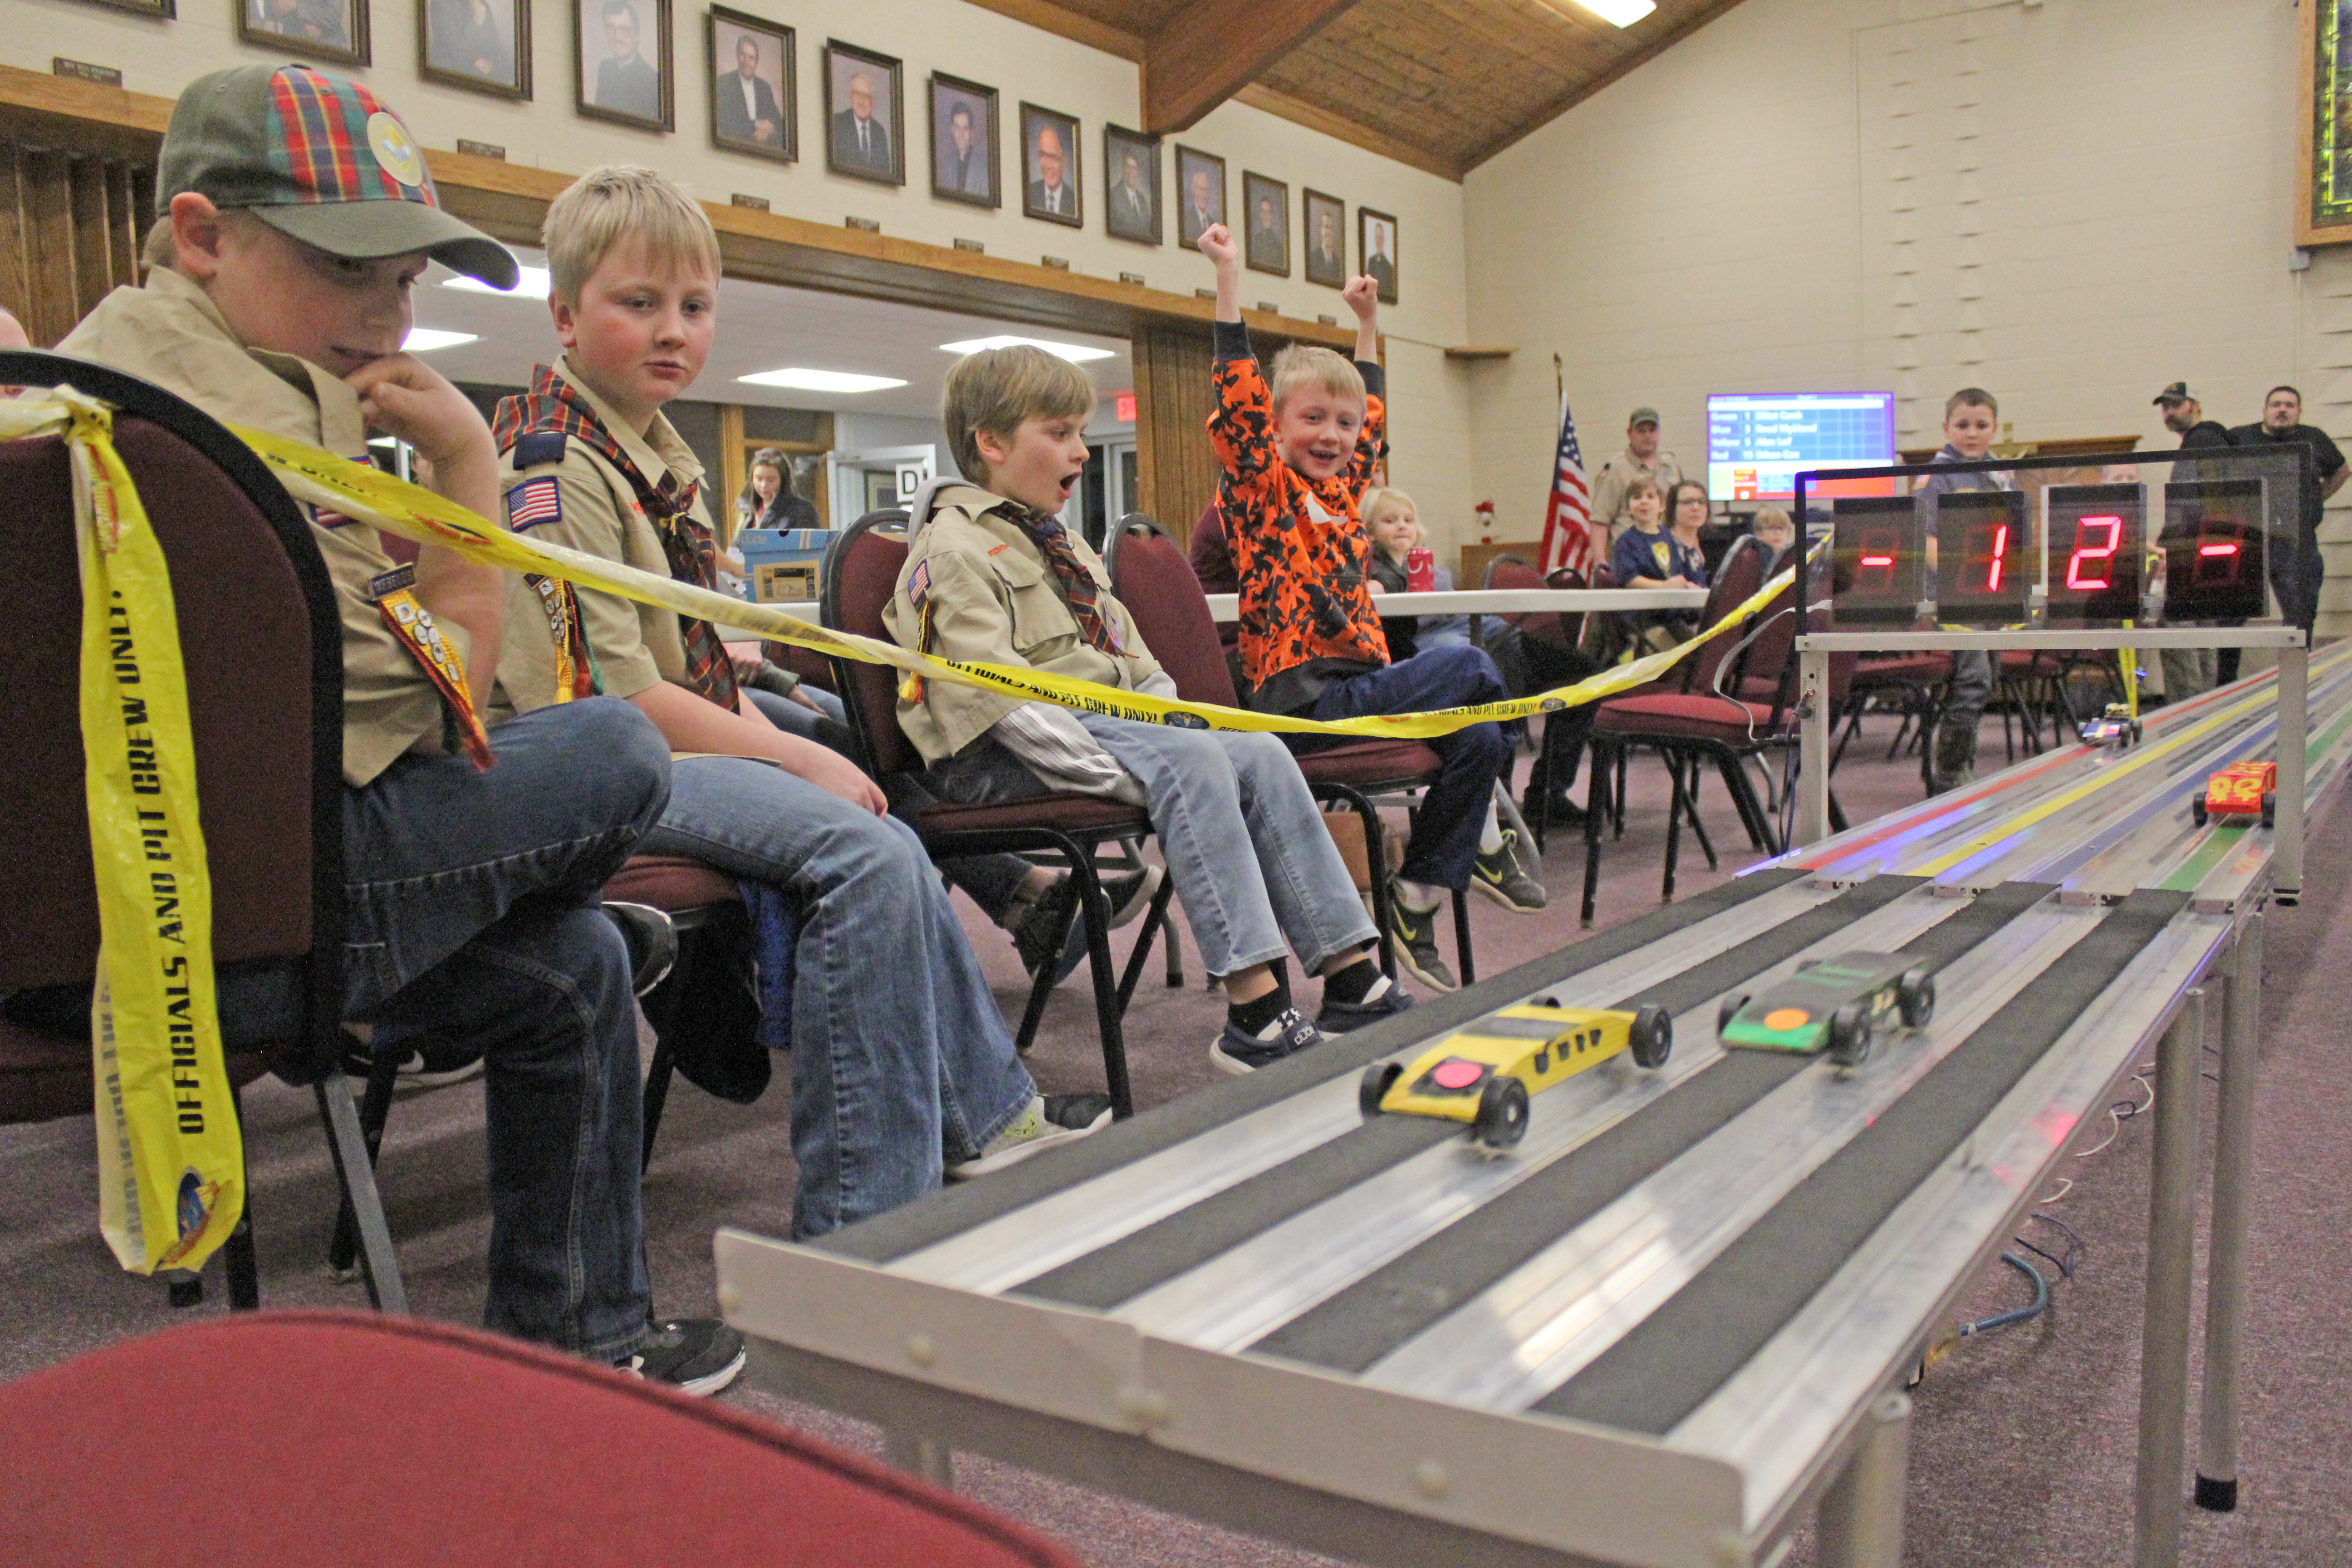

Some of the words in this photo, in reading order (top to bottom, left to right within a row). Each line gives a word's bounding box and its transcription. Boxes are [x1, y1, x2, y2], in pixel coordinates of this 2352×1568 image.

[1711, 437, 1740, 447] Yellow
[1988, 524, 2007, 592] 1
[2066, 515, 2122, 589] 2
[109, 591, 141, 684] ONL
[1085, 696, 1120, 717] CREW
[121, 696, 161, 795] CREW
[136, 805, 172, 861] PIT
[151, 872, 186, 944] AND
[162, 956, 205, 1134] OFFICIALS
